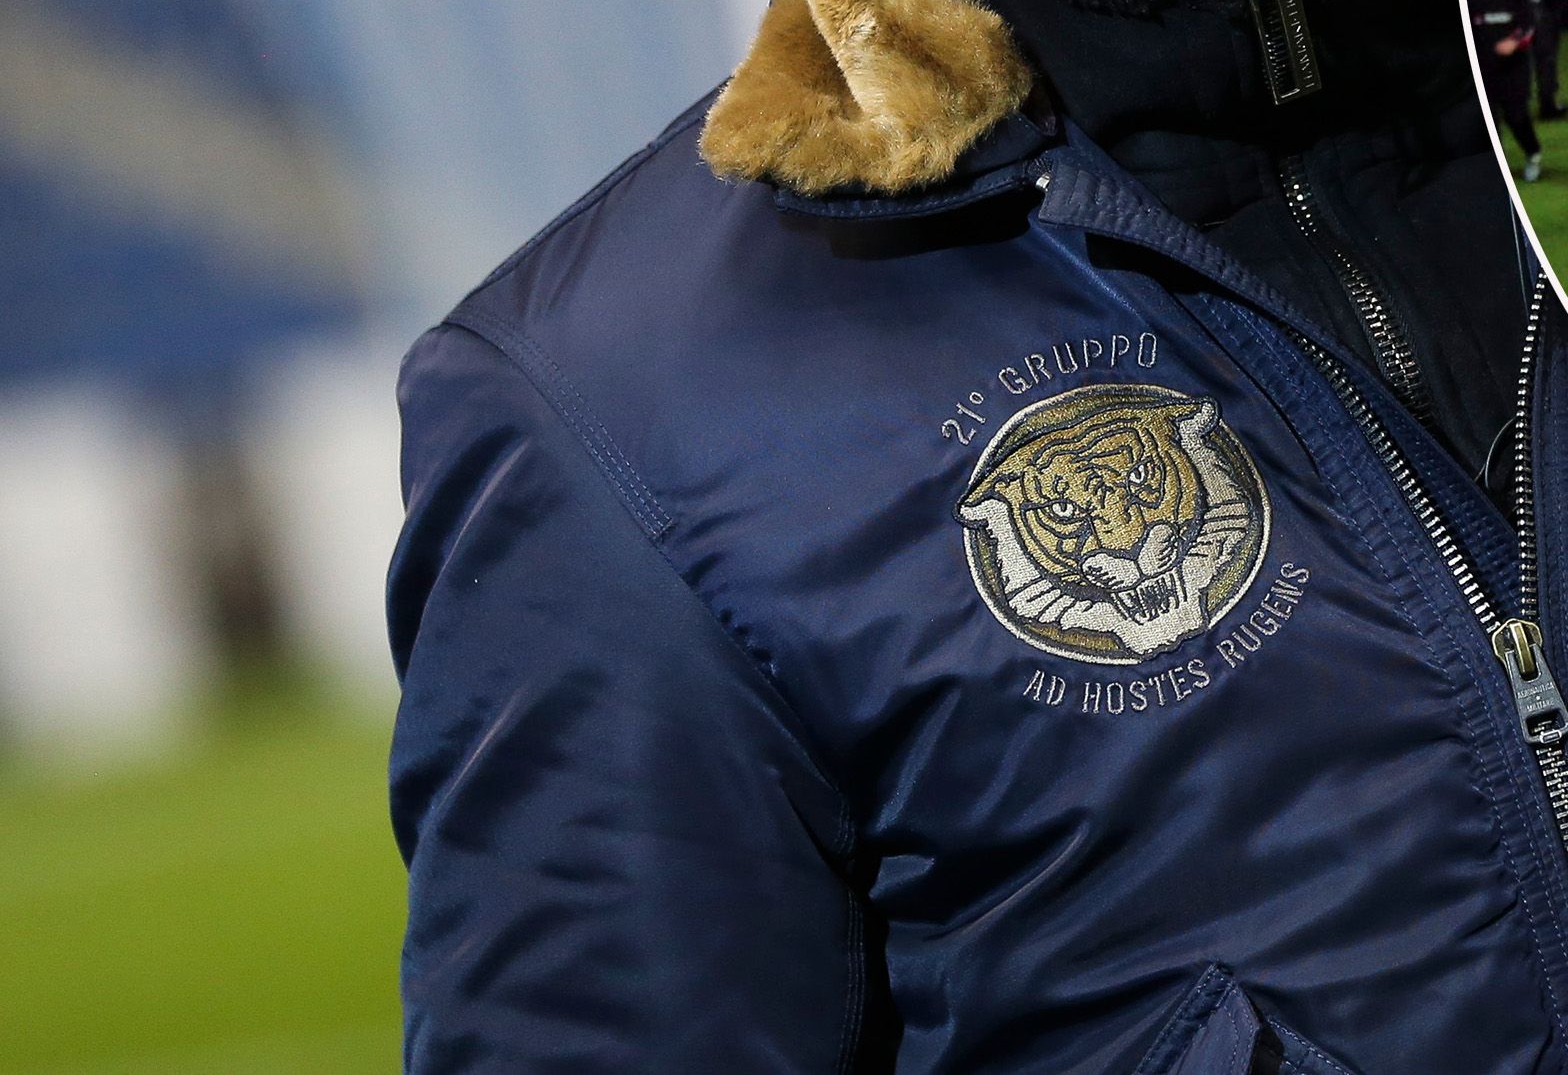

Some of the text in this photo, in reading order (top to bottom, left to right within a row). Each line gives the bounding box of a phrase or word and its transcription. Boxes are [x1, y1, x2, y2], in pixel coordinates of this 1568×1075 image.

[998, 332, 1158, 395] GRUPPO
[1023, 561, 1311, 714] AD HOSTES RUGENS
